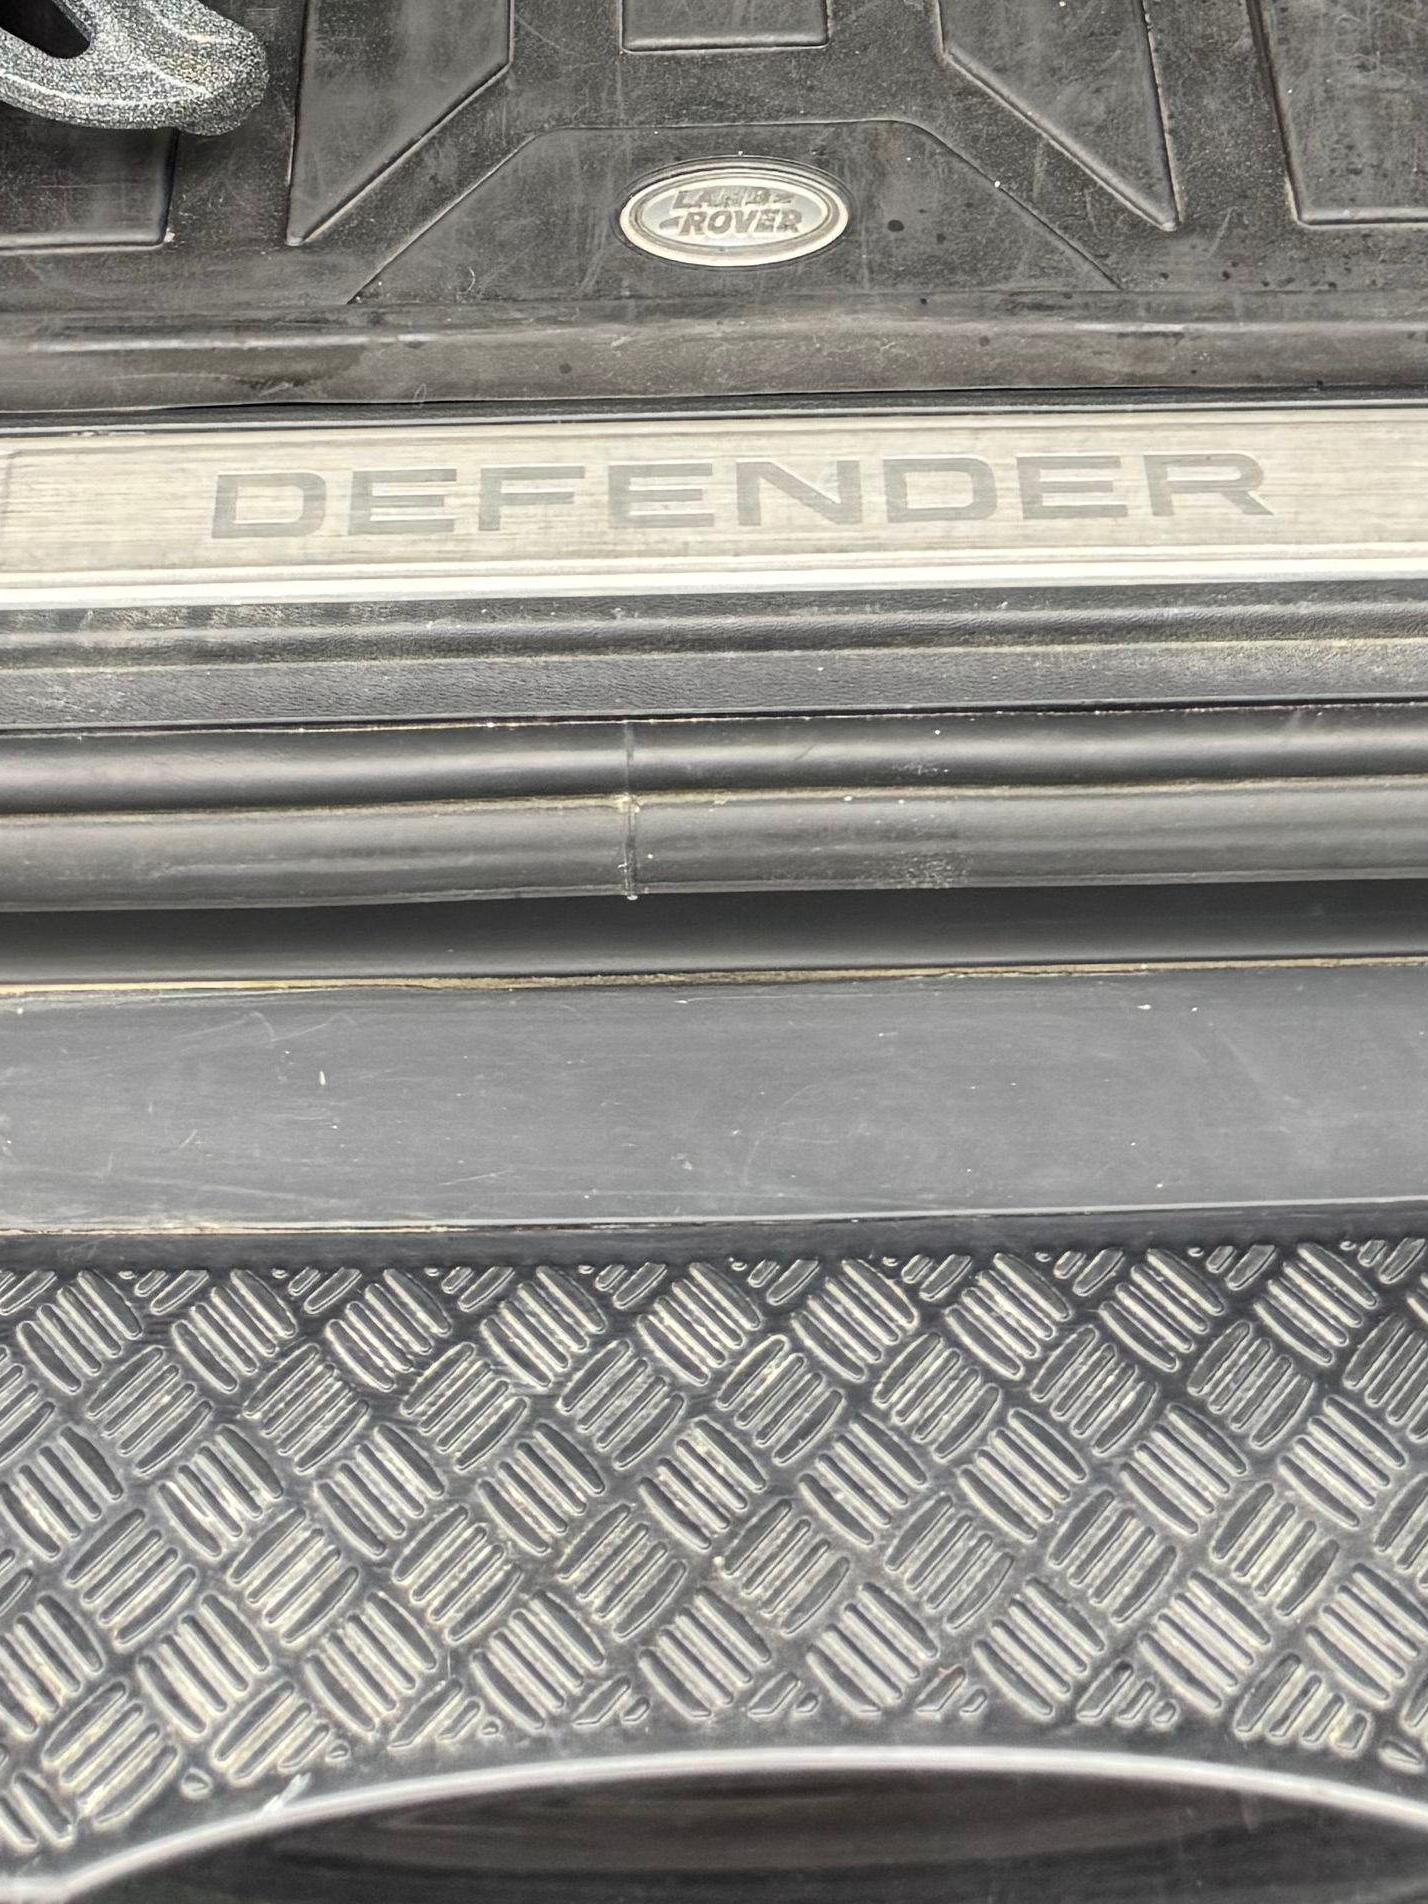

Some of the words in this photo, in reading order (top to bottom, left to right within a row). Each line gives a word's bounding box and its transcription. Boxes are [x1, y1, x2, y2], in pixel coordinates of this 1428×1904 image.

[672, 186, 771, 210] LAND
[678, 209, 802, 237] ROVER
[210, 453, 1275, 538] DEFENDER
